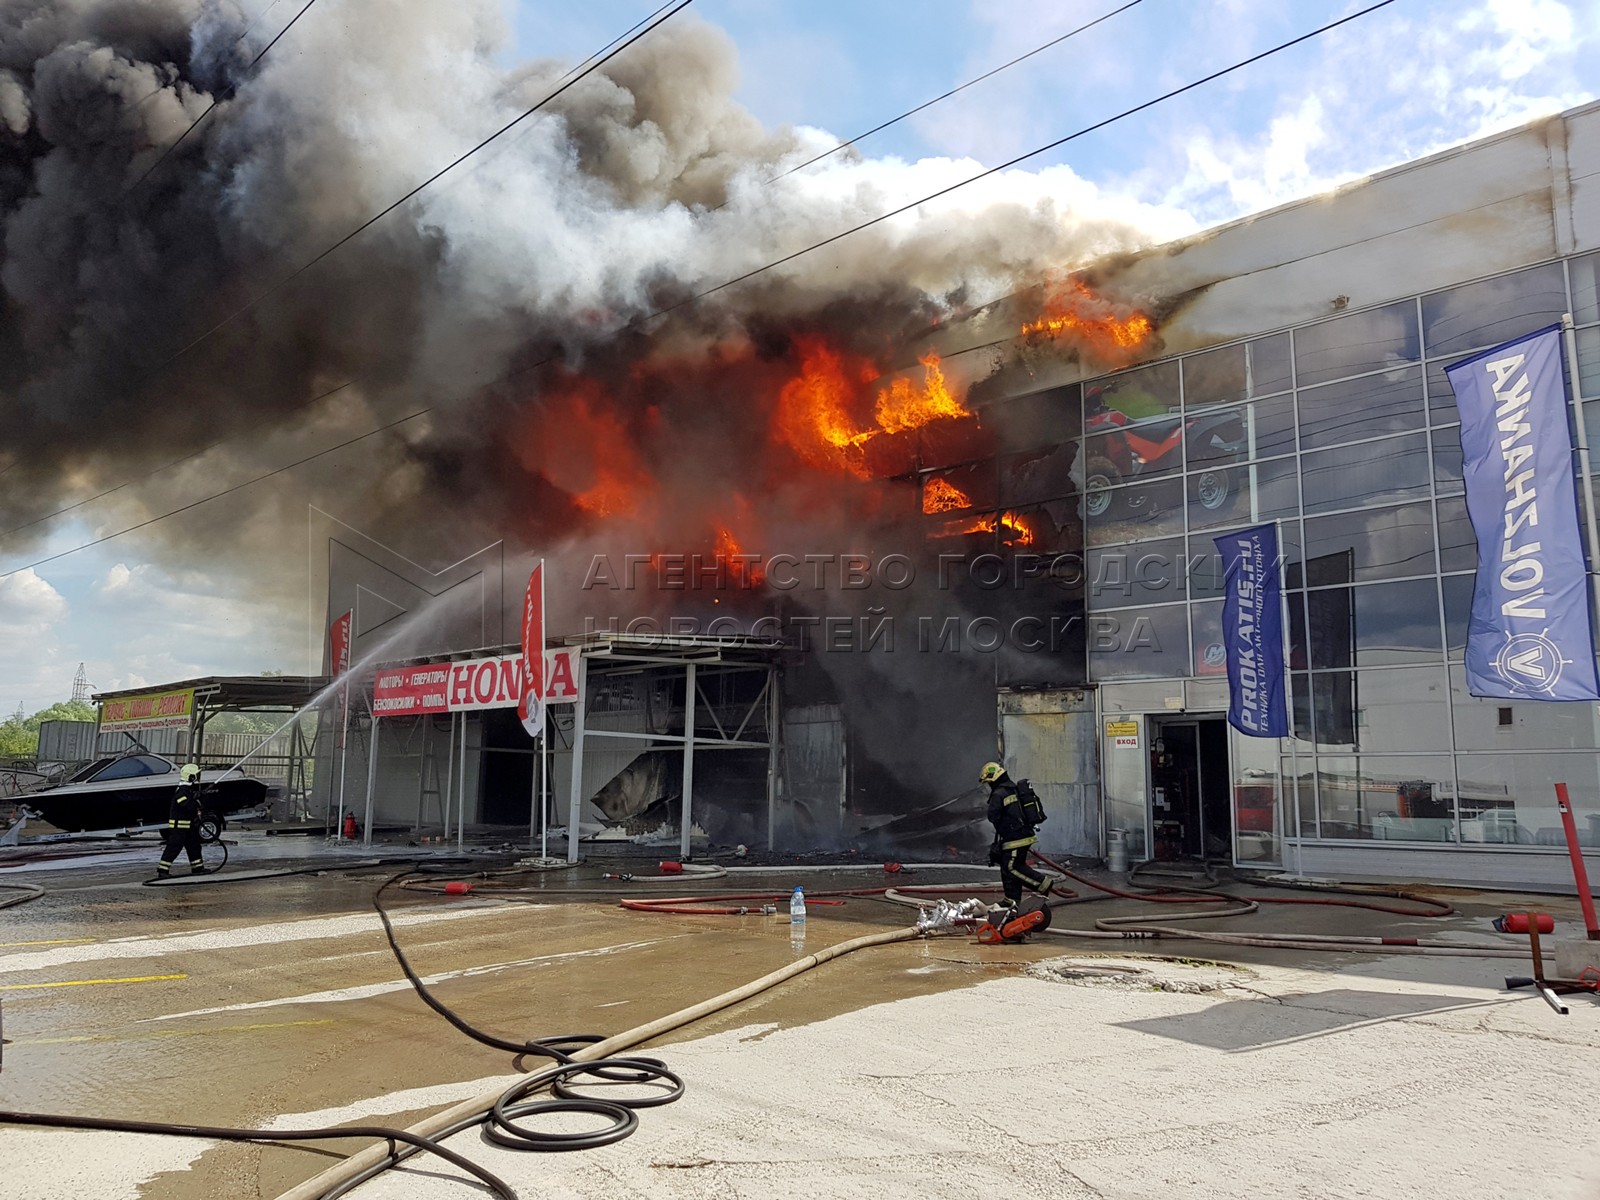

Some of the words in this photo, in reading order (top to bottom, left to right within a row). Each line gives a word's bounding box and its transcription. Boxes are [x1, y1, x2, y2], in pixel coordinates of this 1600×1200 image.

[1237, 539, 1259, 732] PROKATIS.ru
[378, 674, 404, 689] МОТОРЫ
[410, 669, 449, 686] ГЕНЕРАТОРЫ
[450, 652, 578, 705] HONA
[373, 696, 415, 711] БЕНЗОКОСИЛКИ
[422, 693, 446, 708] ПОМПЫ
[1259, 681, 1269, 733] ТЕХНИКА
[1116, 738, 1136, 746] ВХОД
